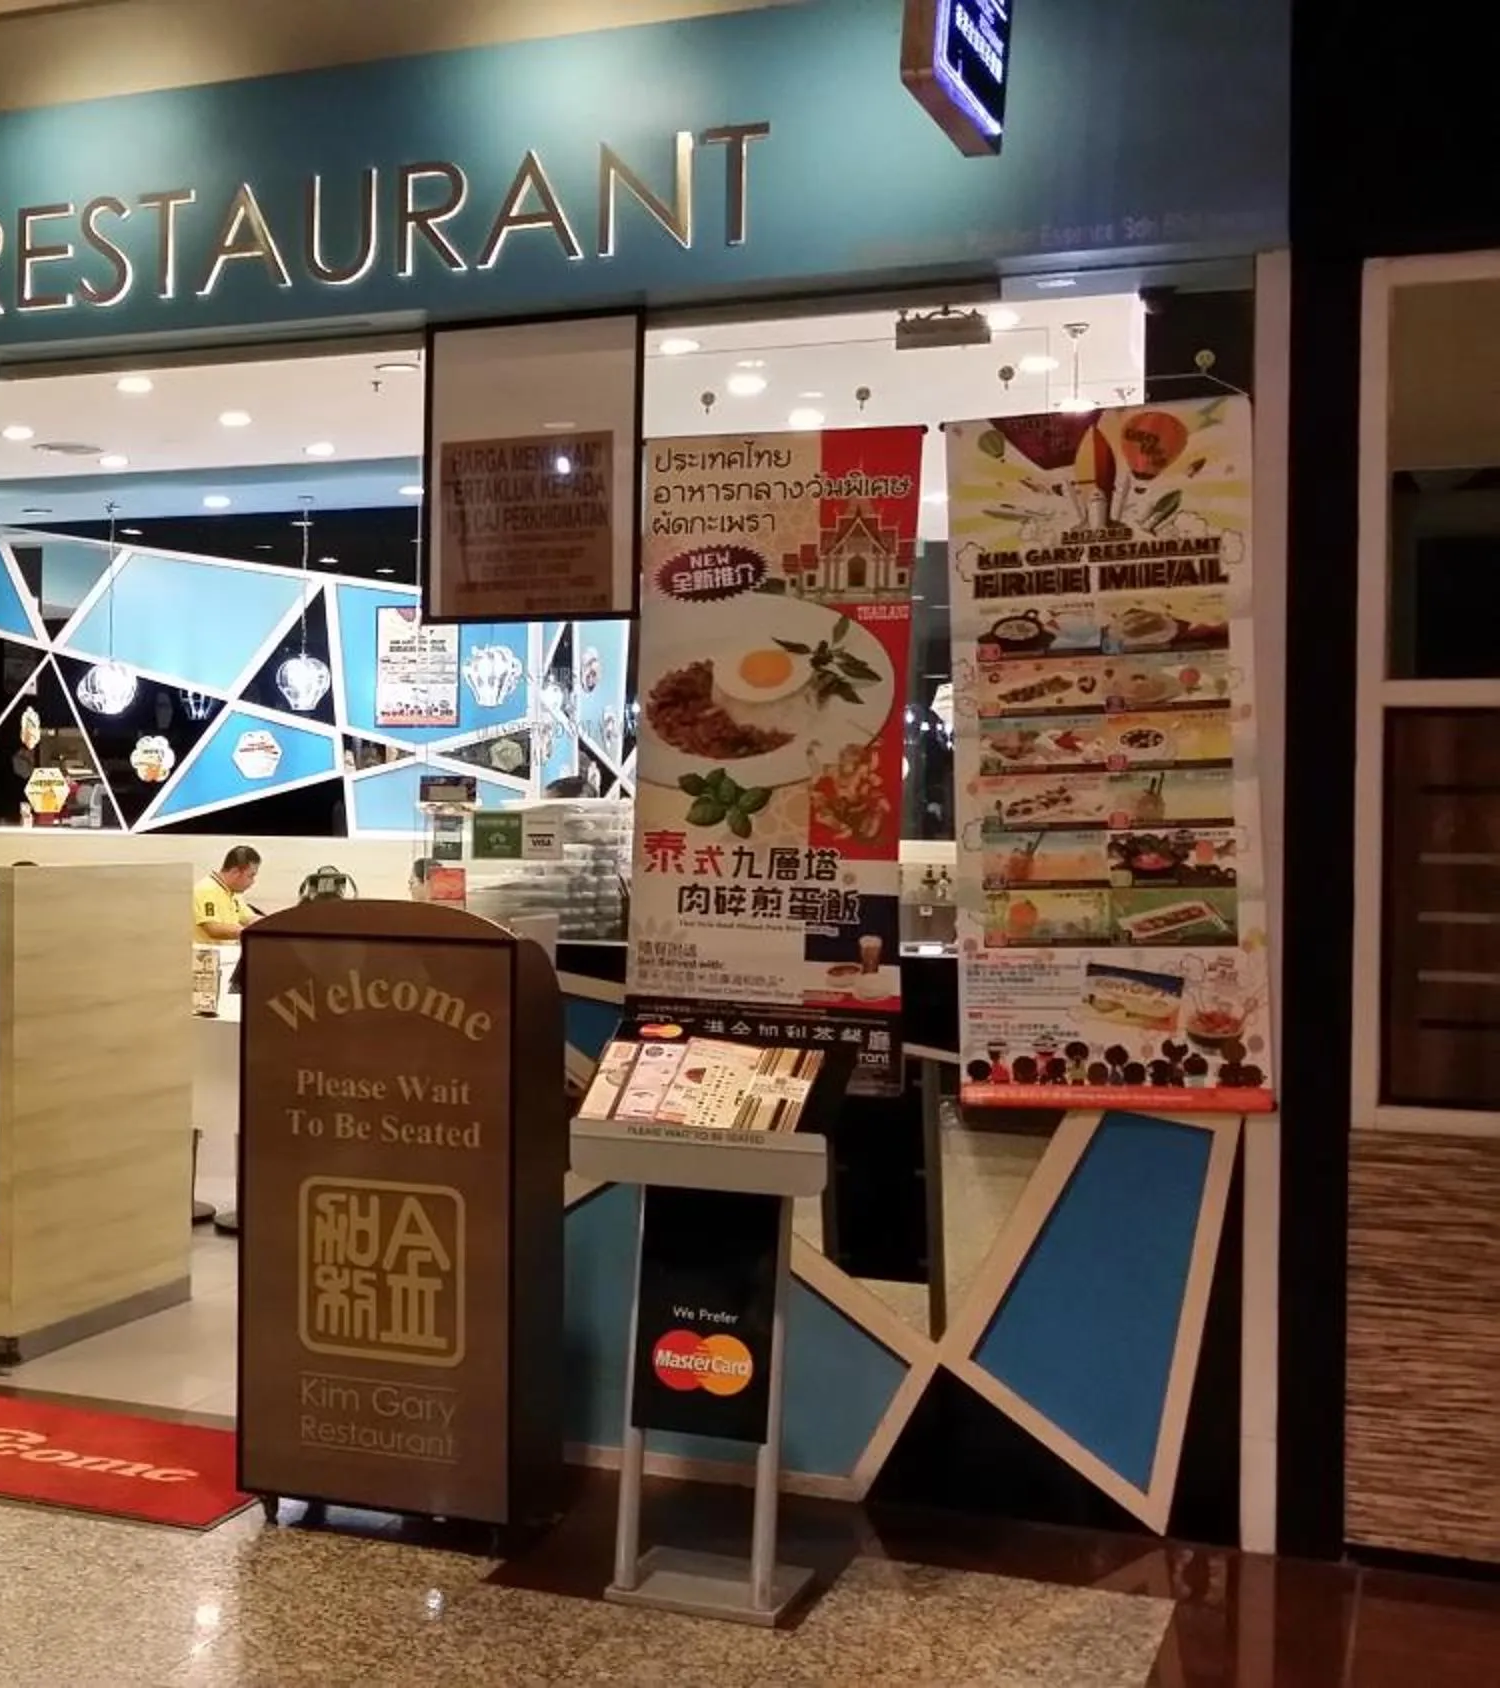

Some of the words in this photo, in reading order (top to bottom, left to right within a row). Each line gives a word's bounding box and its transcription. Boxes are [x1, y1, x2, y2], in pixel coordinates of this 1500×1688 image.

[690, 552, 731, 569] NEW
[977, 551, 1023, 569] KIM
[1025, 545, 1083, 567] GARY
[1089, 537, 1222, 563] RESTAURANT
[973, 566, 1091, 599] FREE
[1100, 558, 1229, 592] MEAL
[643, 830, 840, 881] 泰式九層塔
[677, 883, 860, 924] 肉碎煎蛋飯
[266, 969, 492, 1041] Welcome
[296, 1069, 387, 1100] Please
[397, 1075, 470, 1105] Wait
[285, 1108, 324, 1136] To
[335, 1113, 372, 1140] Be
[380, 1115, 482, 1148] Seated
[673, 1304, 695, 1320] We
[699, 1308, 740, 1325] Prefer
[654, 1349, 752, 1376] MasterCard
[300, 1378, 360, 1411] Kim
[372, 1386, 456, 1427] Gary
[300, 1415, 455, 1457] Restaurant
